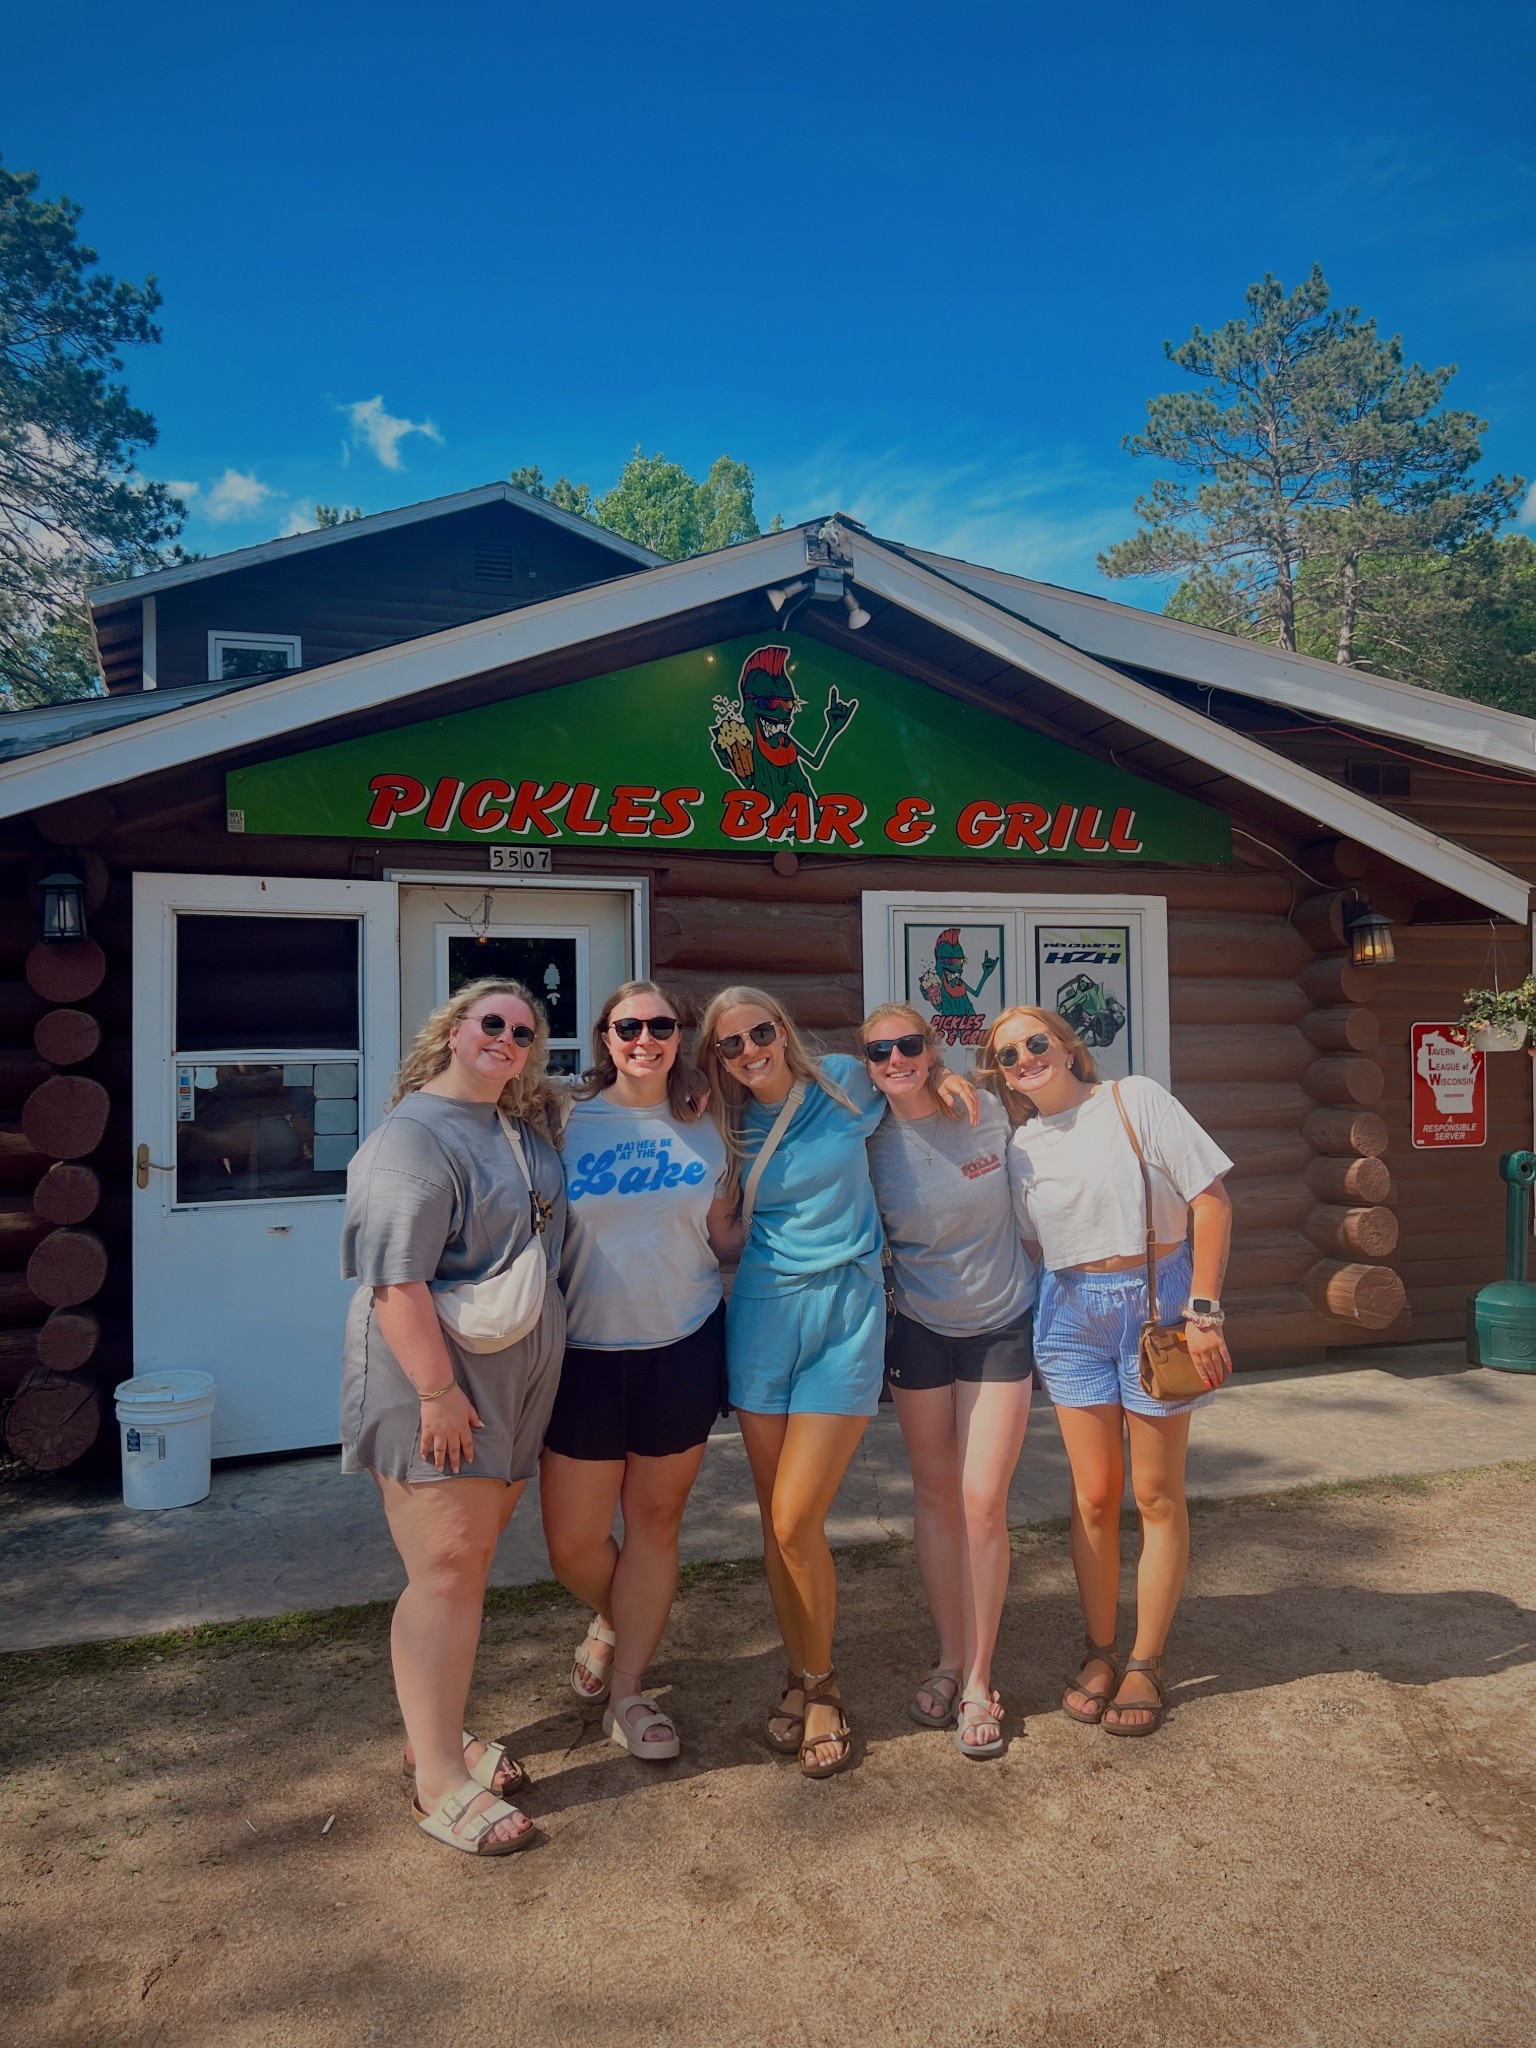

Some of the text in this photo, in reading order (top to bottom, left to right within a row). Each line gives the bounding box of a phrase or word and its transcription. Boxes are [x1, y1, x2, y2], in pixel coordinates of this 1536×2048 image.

[367, 774, 1144, 855] PICKLES BAR & GRILL
[493, 849, 549, 869] 5507
[1044, 951, 1122, 965] HZH
[931, 1014, 986, 1030] PICKLES
[1425, 1043, 1455, 1056] TAVERN
[1428, 1058, 1460, 1071] LEAGUE
[1428, 1074, 1474, 1086] WISCONSIN
[1447, 1115, 1453, 1123] A
[1423, 1123, 1477, 1132] RESPONSIBLE
[1434, 1132, 1466, 1140] SERVER
[616, 1138, 672, 1152] RATHER BE
[618, 1148, 656, 1161] AT THE
[568, 1149, 706, 1200] Lake
